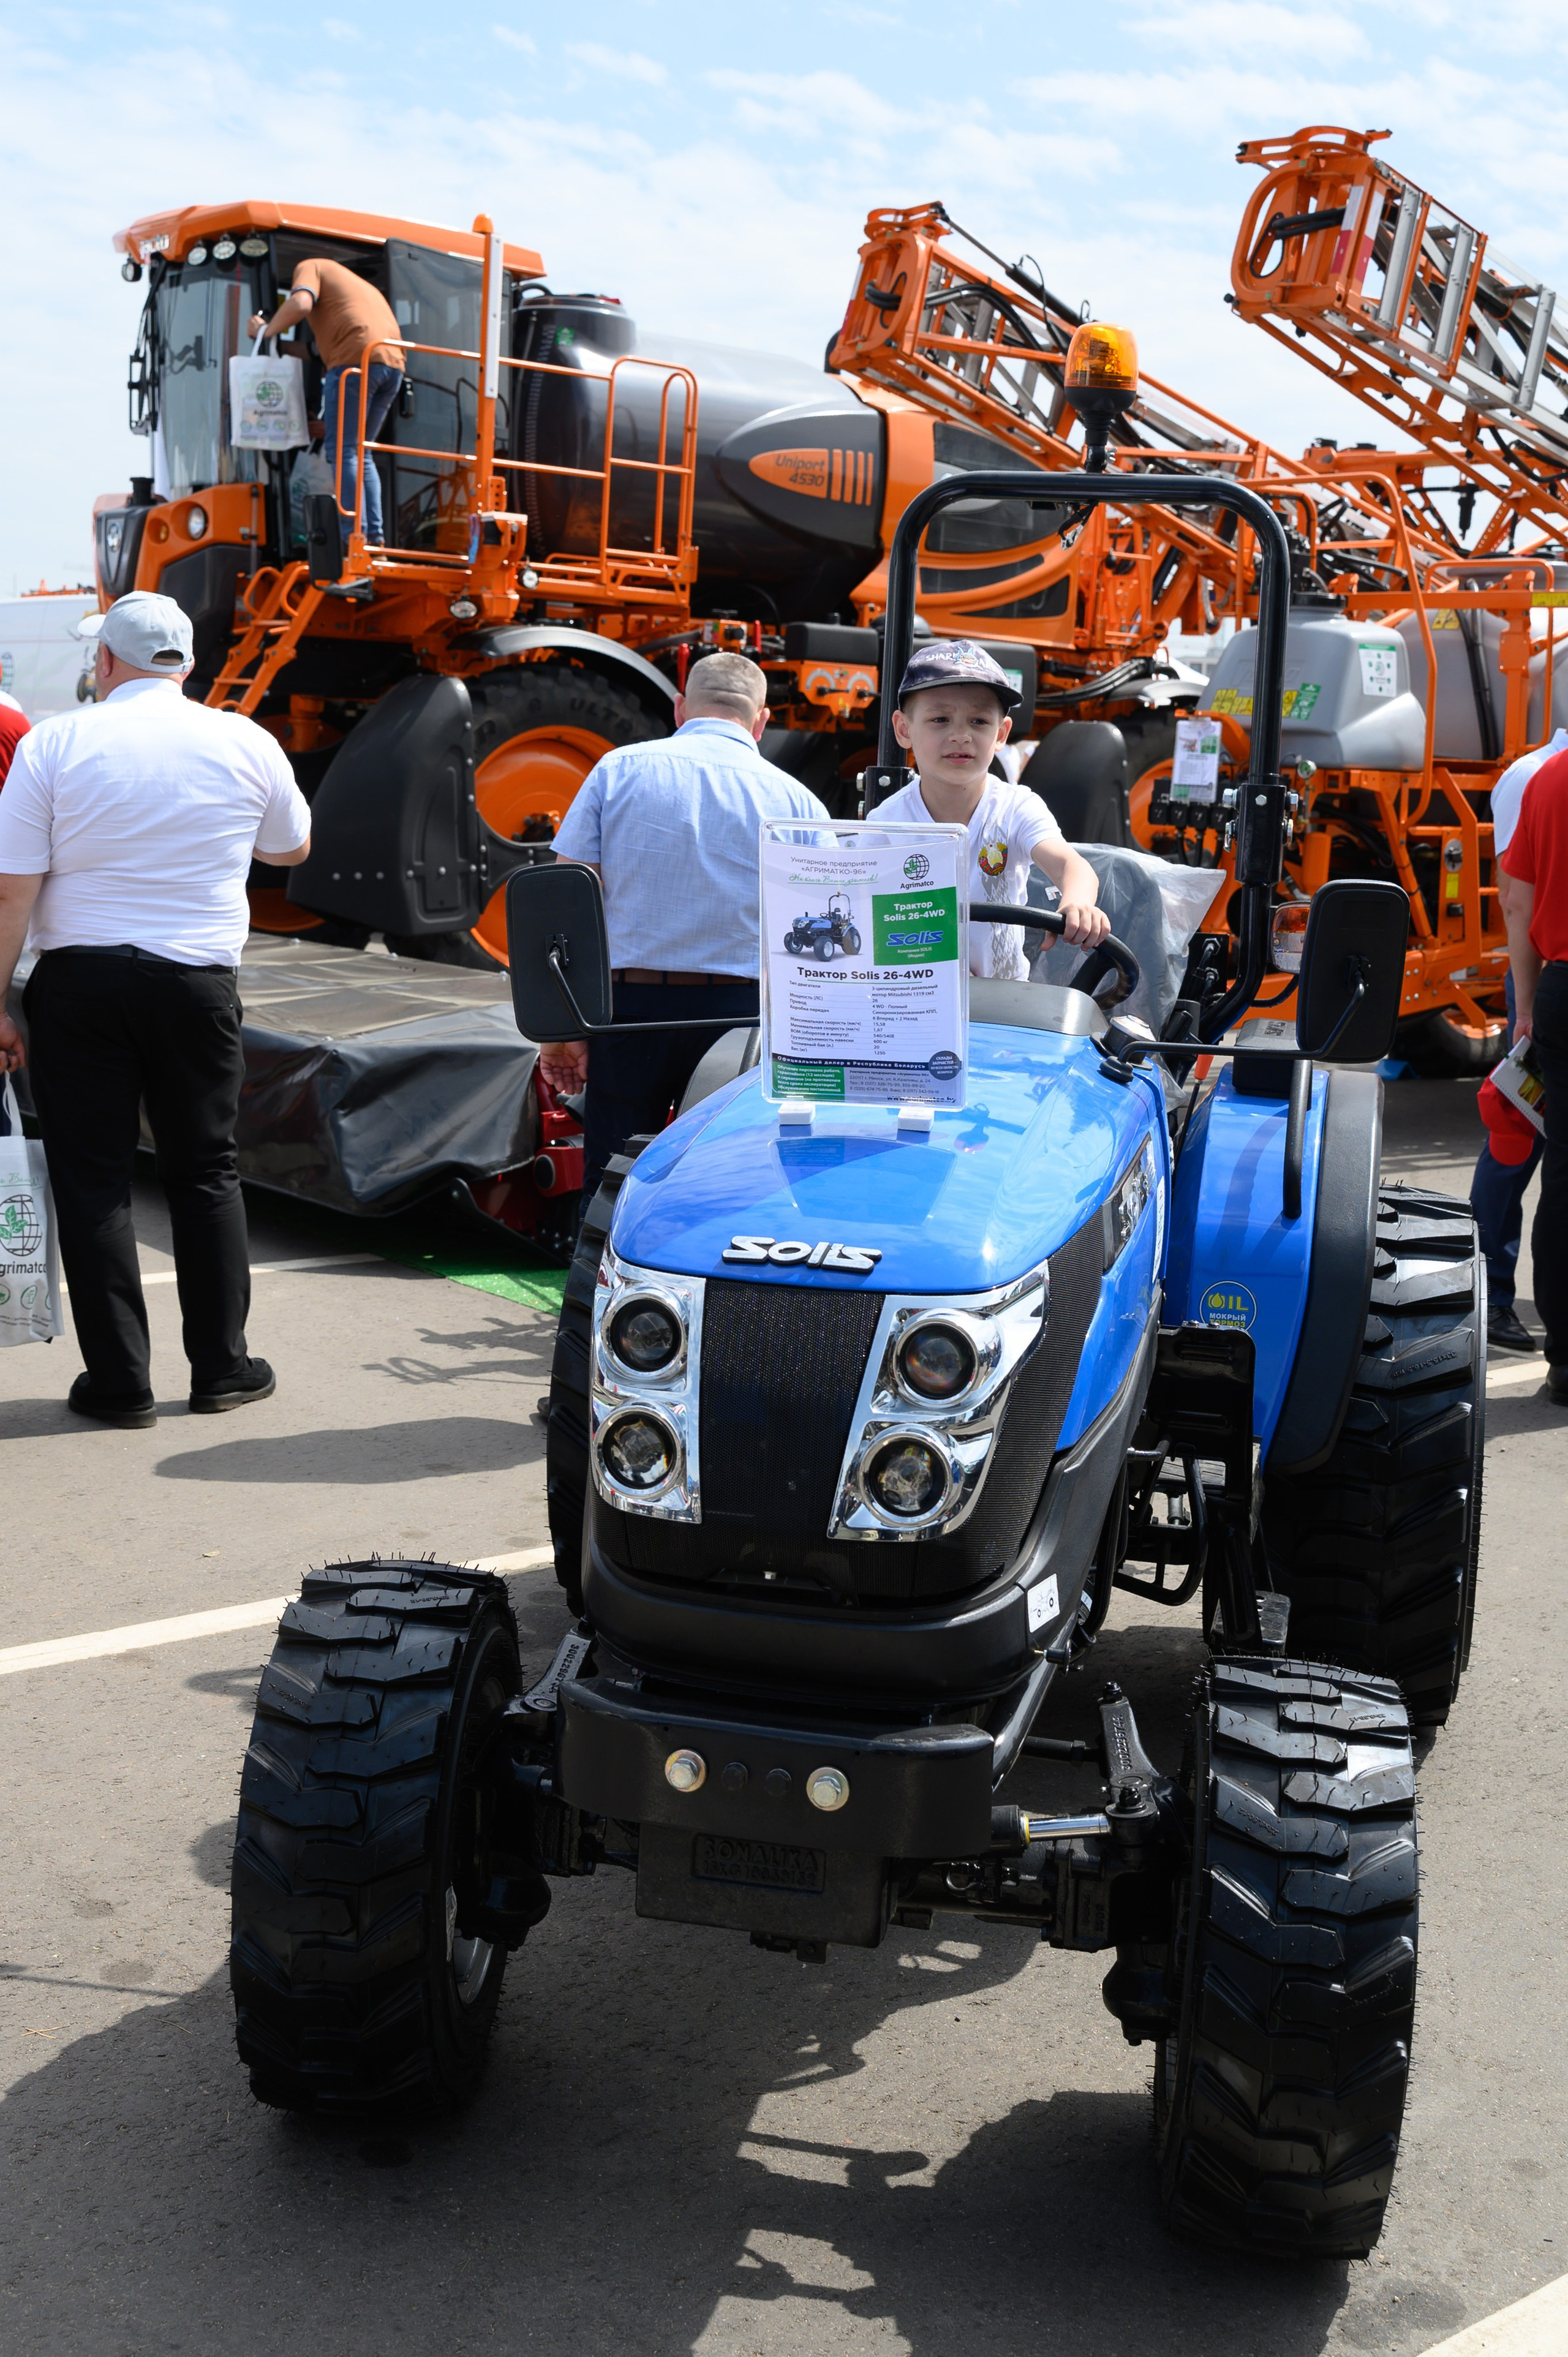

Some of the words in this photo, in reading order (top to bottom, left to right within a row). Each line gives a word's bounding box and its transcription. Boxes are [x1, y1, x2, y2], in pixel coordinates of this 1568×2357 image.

[775, 454, 825, 472] Uniport
[789, 472, 824, 486] 4530
[790, 856, 827, 866] Унитарное
[801, 866, 867, 875] «АГРИМАТКО-96»
[900, 881, 934, 890] Agrimatco
[894, 902, 933, 911] Трактор
[908, 909, 945, 920] 26-4WD
[797, 967, 848, 981] Трактор
[851, 971, 880, 980] Solis
[883, 969, 933, 980] 26-4WD
[777, 1055, 822, 1065] Официальный
[1208, 1292, 1248, 1310] OIL
[1209, 1313, 1246, 1321] МОКРЫЙ
[704, 1838, 818, 1872] SONALIKA
